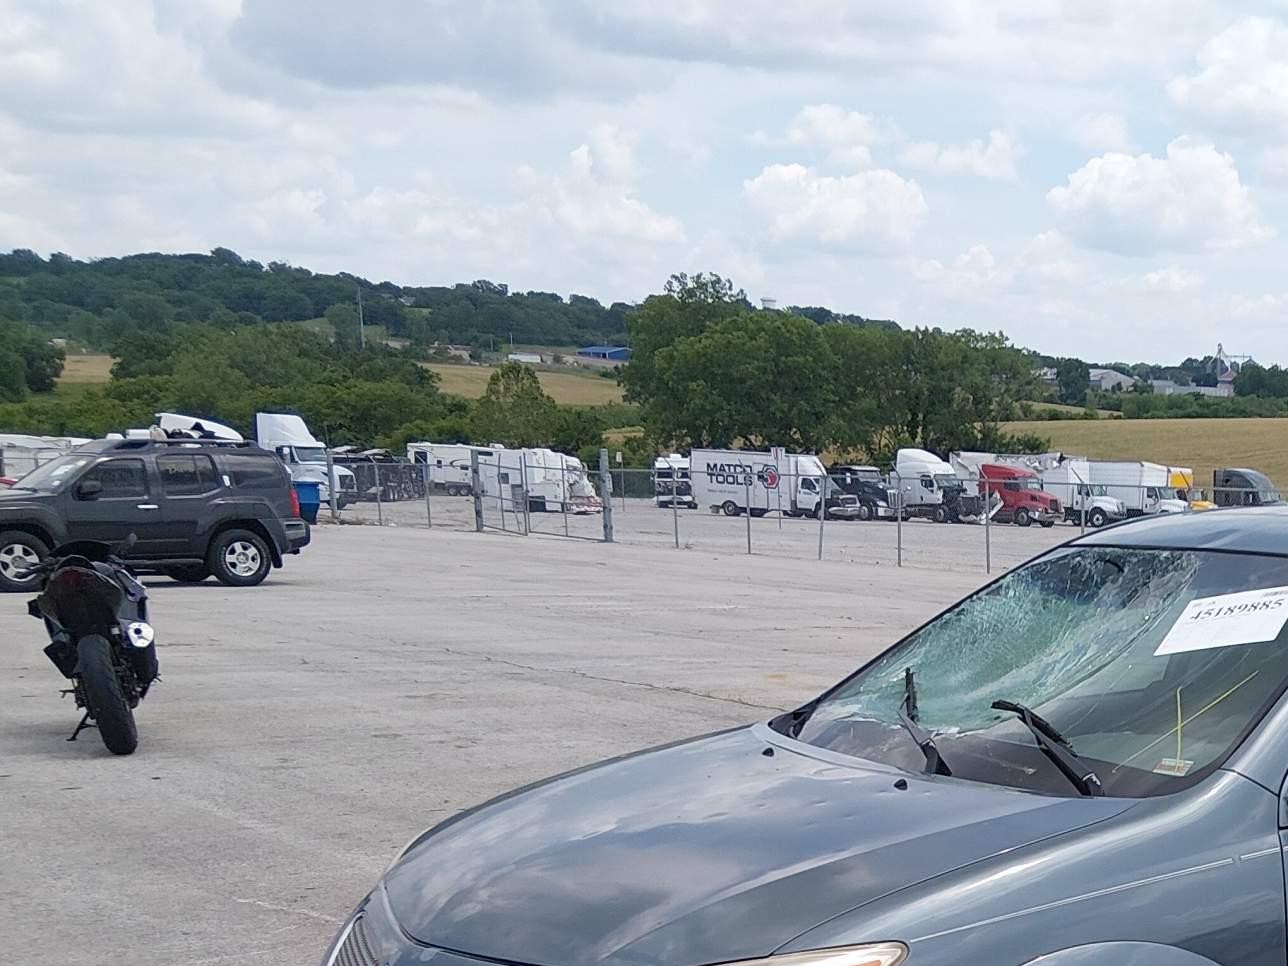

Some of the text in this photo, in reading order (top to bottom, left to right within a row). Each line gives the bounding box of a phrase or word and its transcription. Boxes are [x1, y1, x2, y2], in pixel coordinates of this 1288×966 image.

[706, 462, 753, 474] MATCO
[706, 473, 753, 486] TOOLS
[1190, 599, 1285, 620] 45189885
